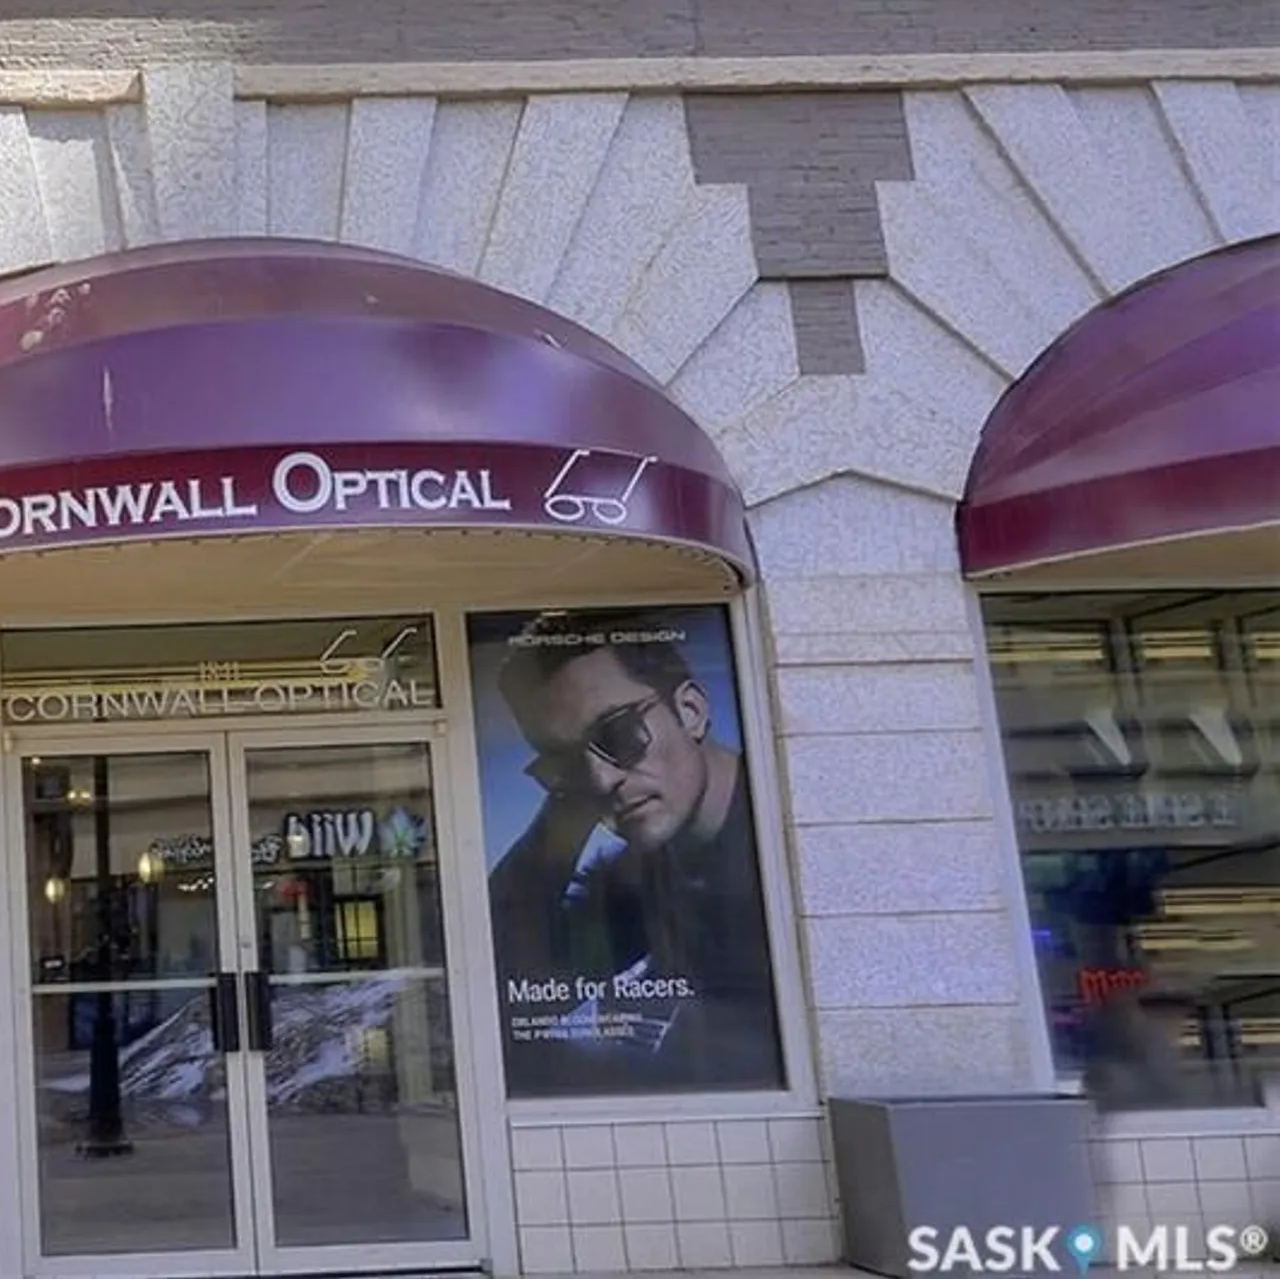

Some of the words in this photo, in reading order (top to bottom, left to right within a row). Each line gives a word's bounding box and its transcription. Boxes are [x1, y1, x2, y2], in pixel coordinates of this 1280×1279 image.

[271, 451, 511, 513] OPTICAL
[7, 688, 248, 721] CORNWALL
[253, 680, 432, 712] OPTICAL
[508, 978, 570, 1003] Made
[575, 976, 607, 1000] for
[613, 977, 694, 999] Racers.
